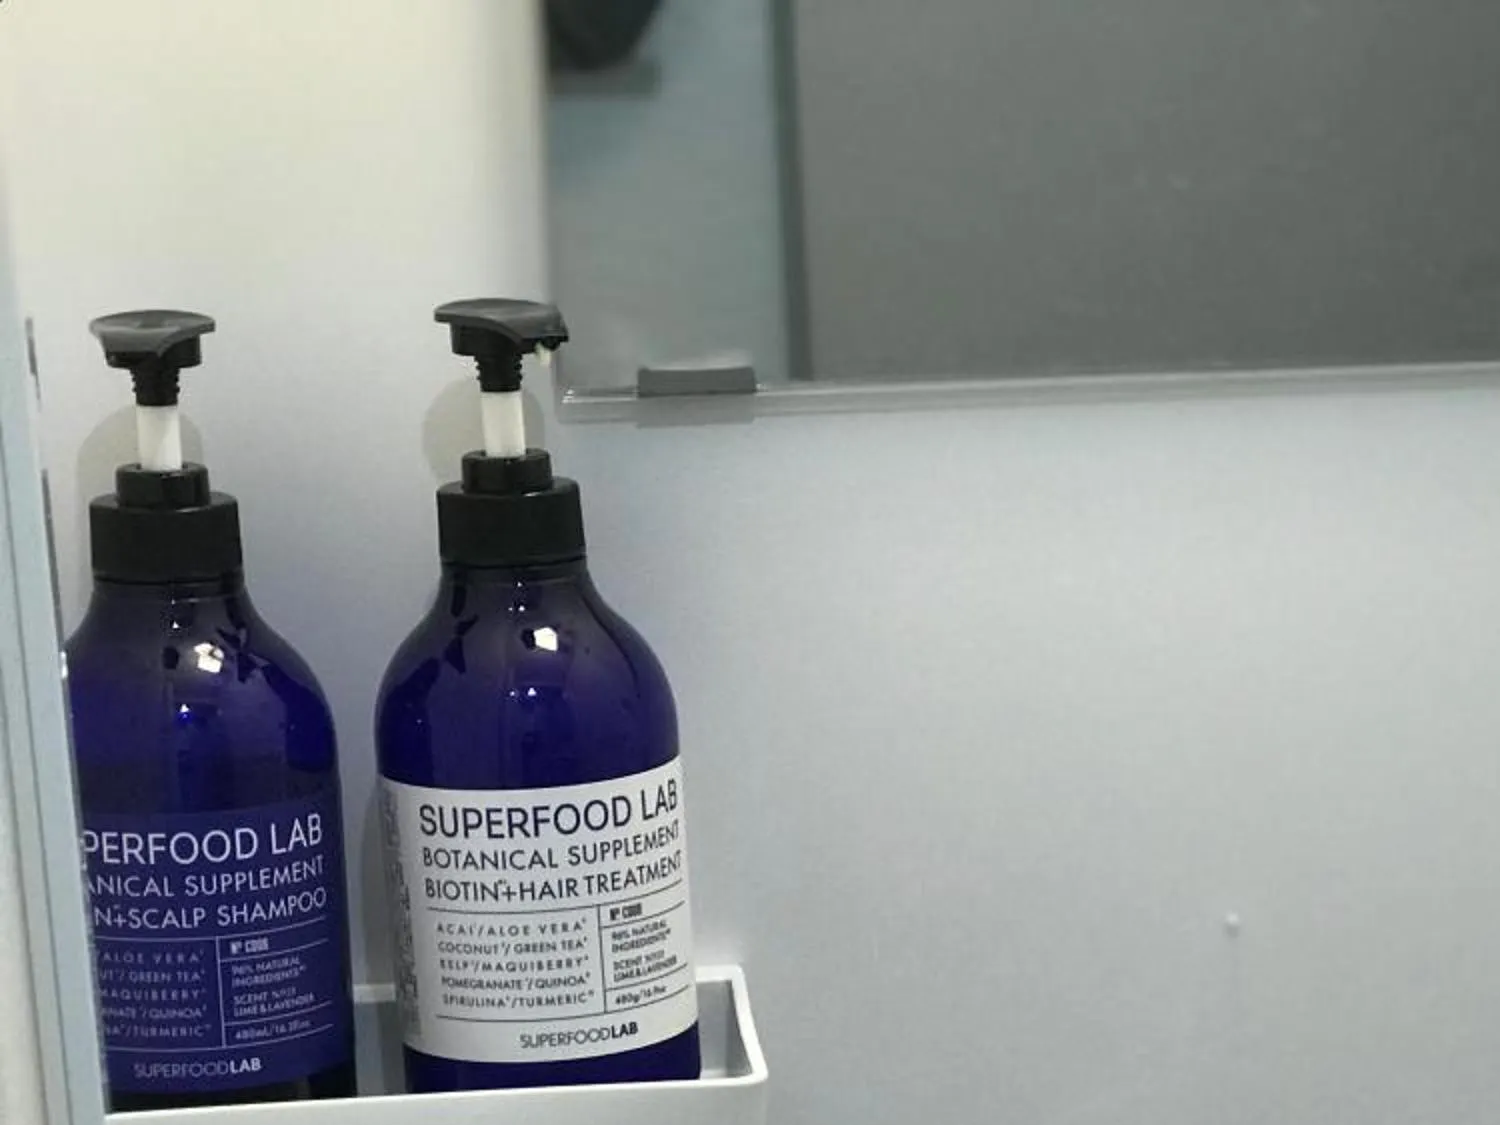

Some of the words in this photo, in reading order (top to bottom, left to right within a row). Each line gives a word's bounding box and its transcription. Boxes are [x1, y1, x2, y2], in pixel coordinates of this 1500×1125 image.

[419, 795, 631, 839] SUPERFOOD
[641, 778, 677, 821] LAB
[82, 827, 258, 865] PERFOOD
[270, 813, 322, 855] LAB
[423, 847, 558, 870] BOTANICAL
[568, 818, 679, 866] SUPPLEMENT
[185, 855, 323, 896] SUPPLEMENT
[583, 849, 681, 895] TREATMENT
[217, 887, 327, 926] SHAMPOO
